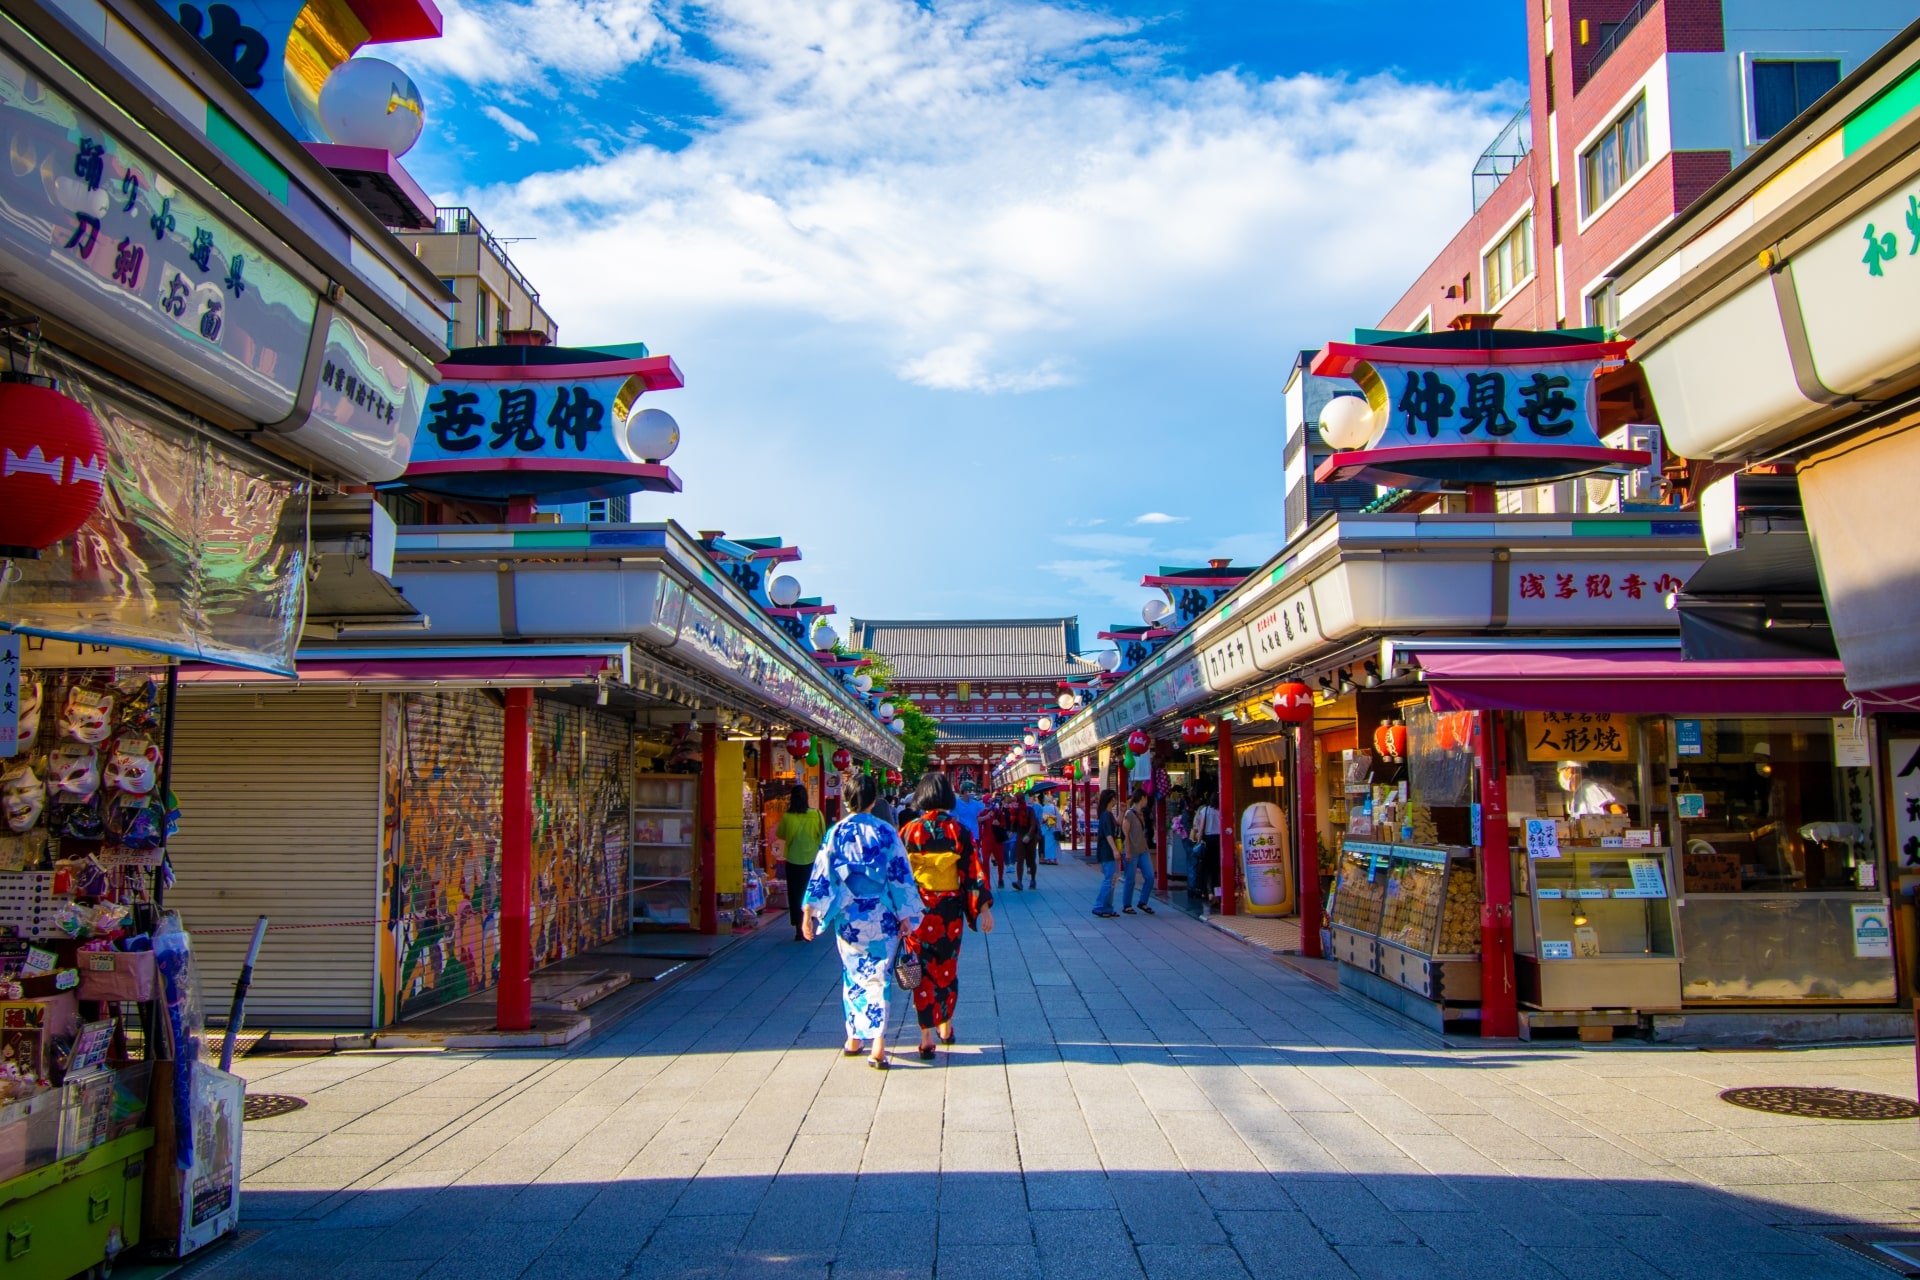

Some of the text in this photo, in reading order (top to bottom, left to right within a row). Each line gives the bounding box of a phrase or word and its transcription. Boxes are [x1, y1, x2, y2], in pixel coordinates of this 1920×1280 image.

[322, 360, 394, 425] 創業明治十七年
[1399, 371, 1577, 437] 仲見世
[1210, 637, 1244, 677] カワチヤ
[1534, 725, 1623, 752] 人形焼
